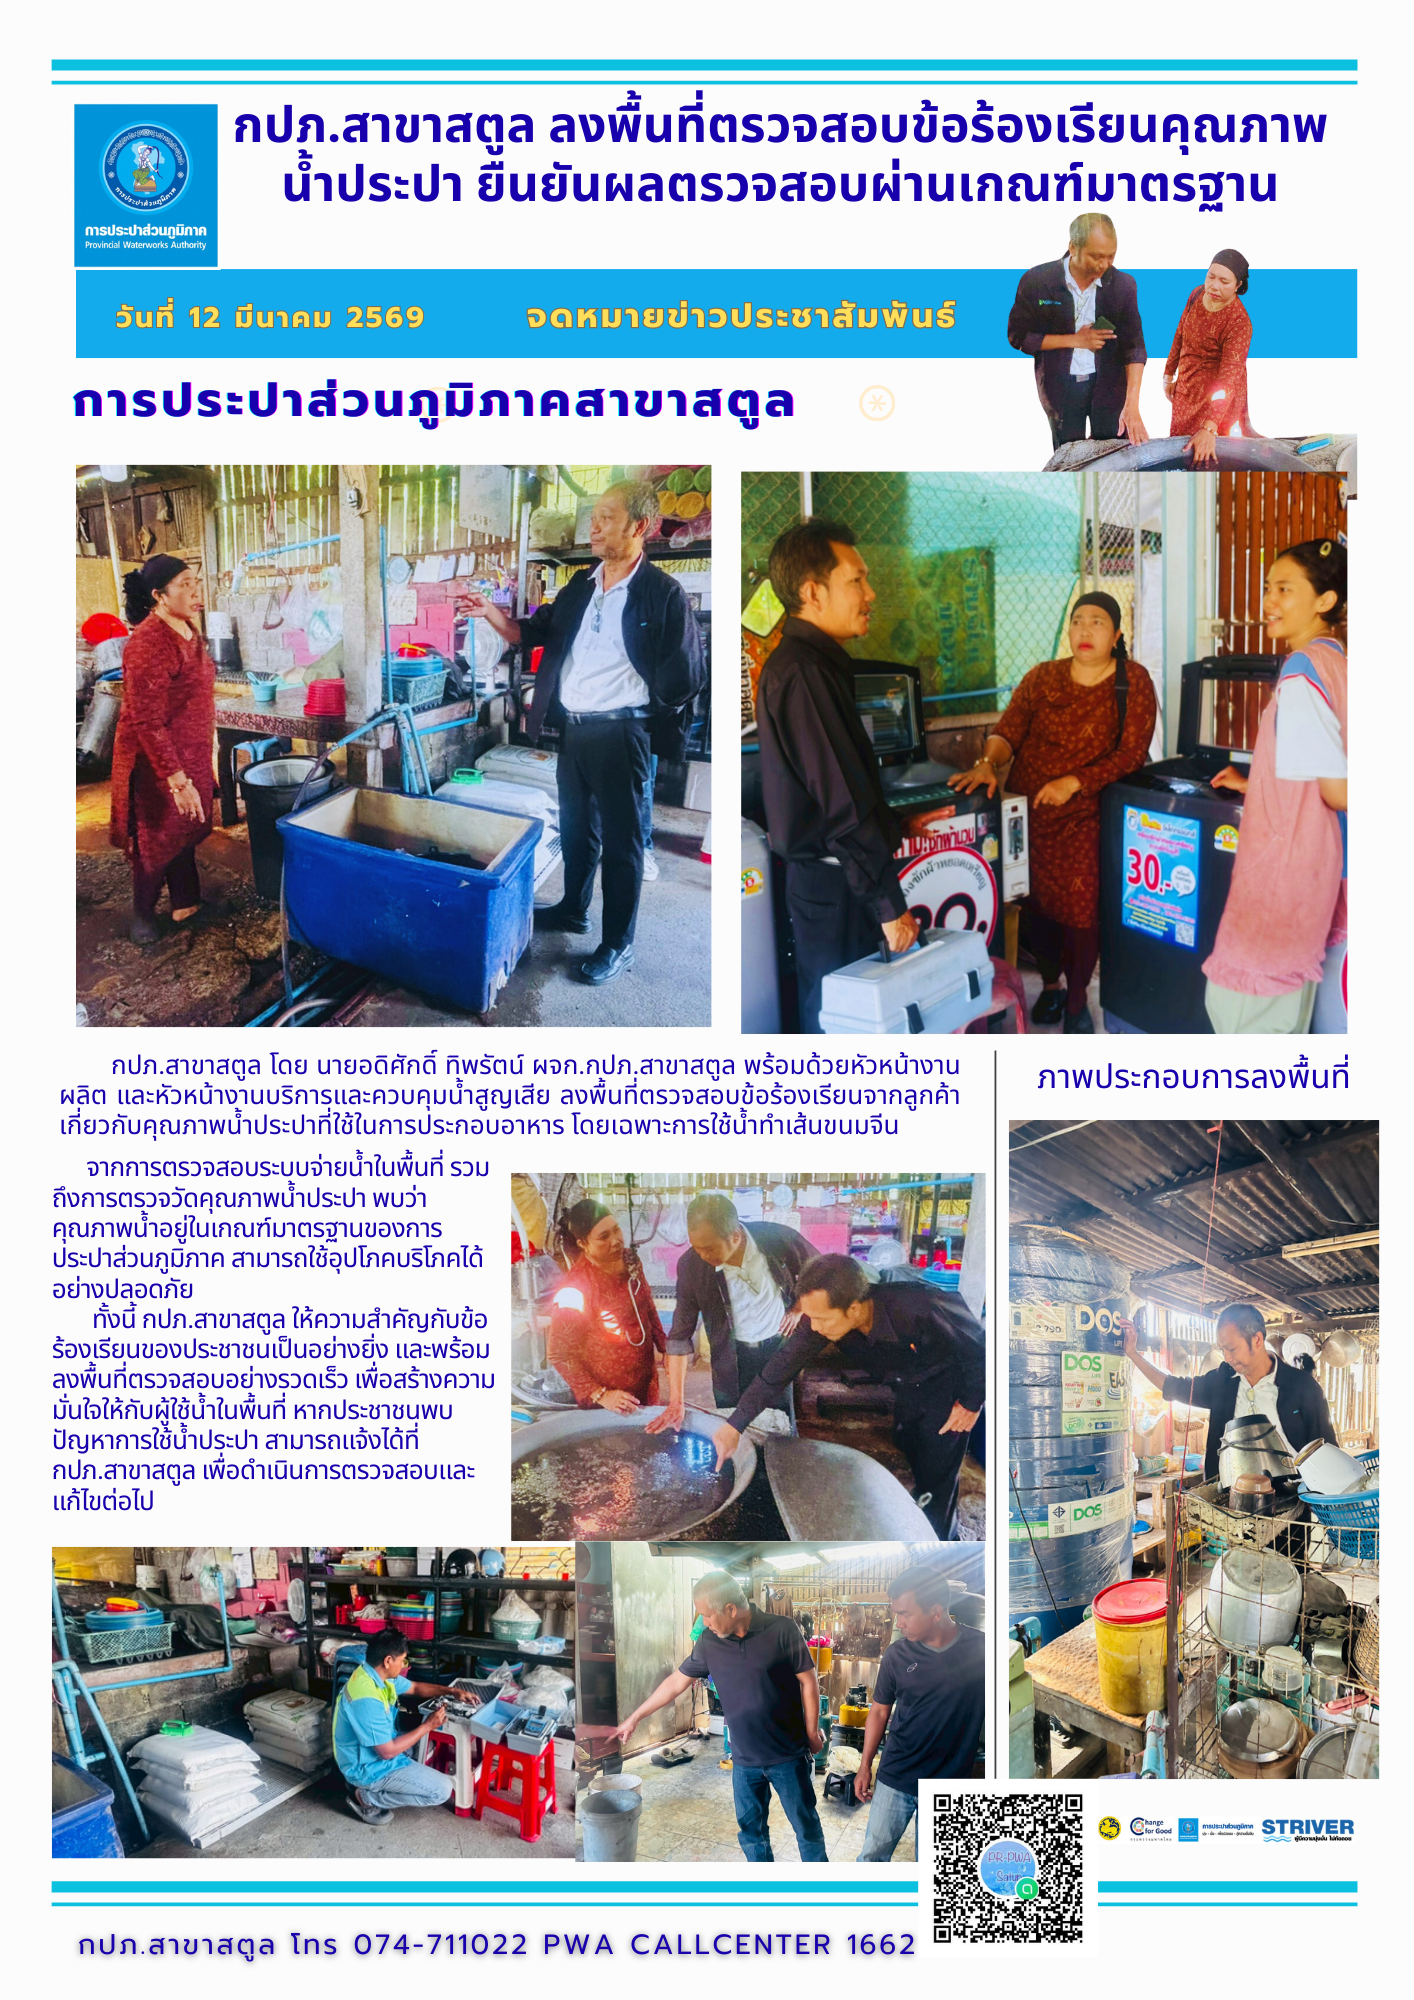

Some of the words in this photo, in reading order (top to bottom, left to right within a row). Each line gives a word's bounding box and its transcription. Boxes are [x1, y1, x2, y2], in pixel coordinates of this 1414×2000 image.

[1075, 1304, 1123, 1337] DOS
[1064, 1353, 1103, 1372] DOS
[1073, 1503, 1102, 1521] DOS
